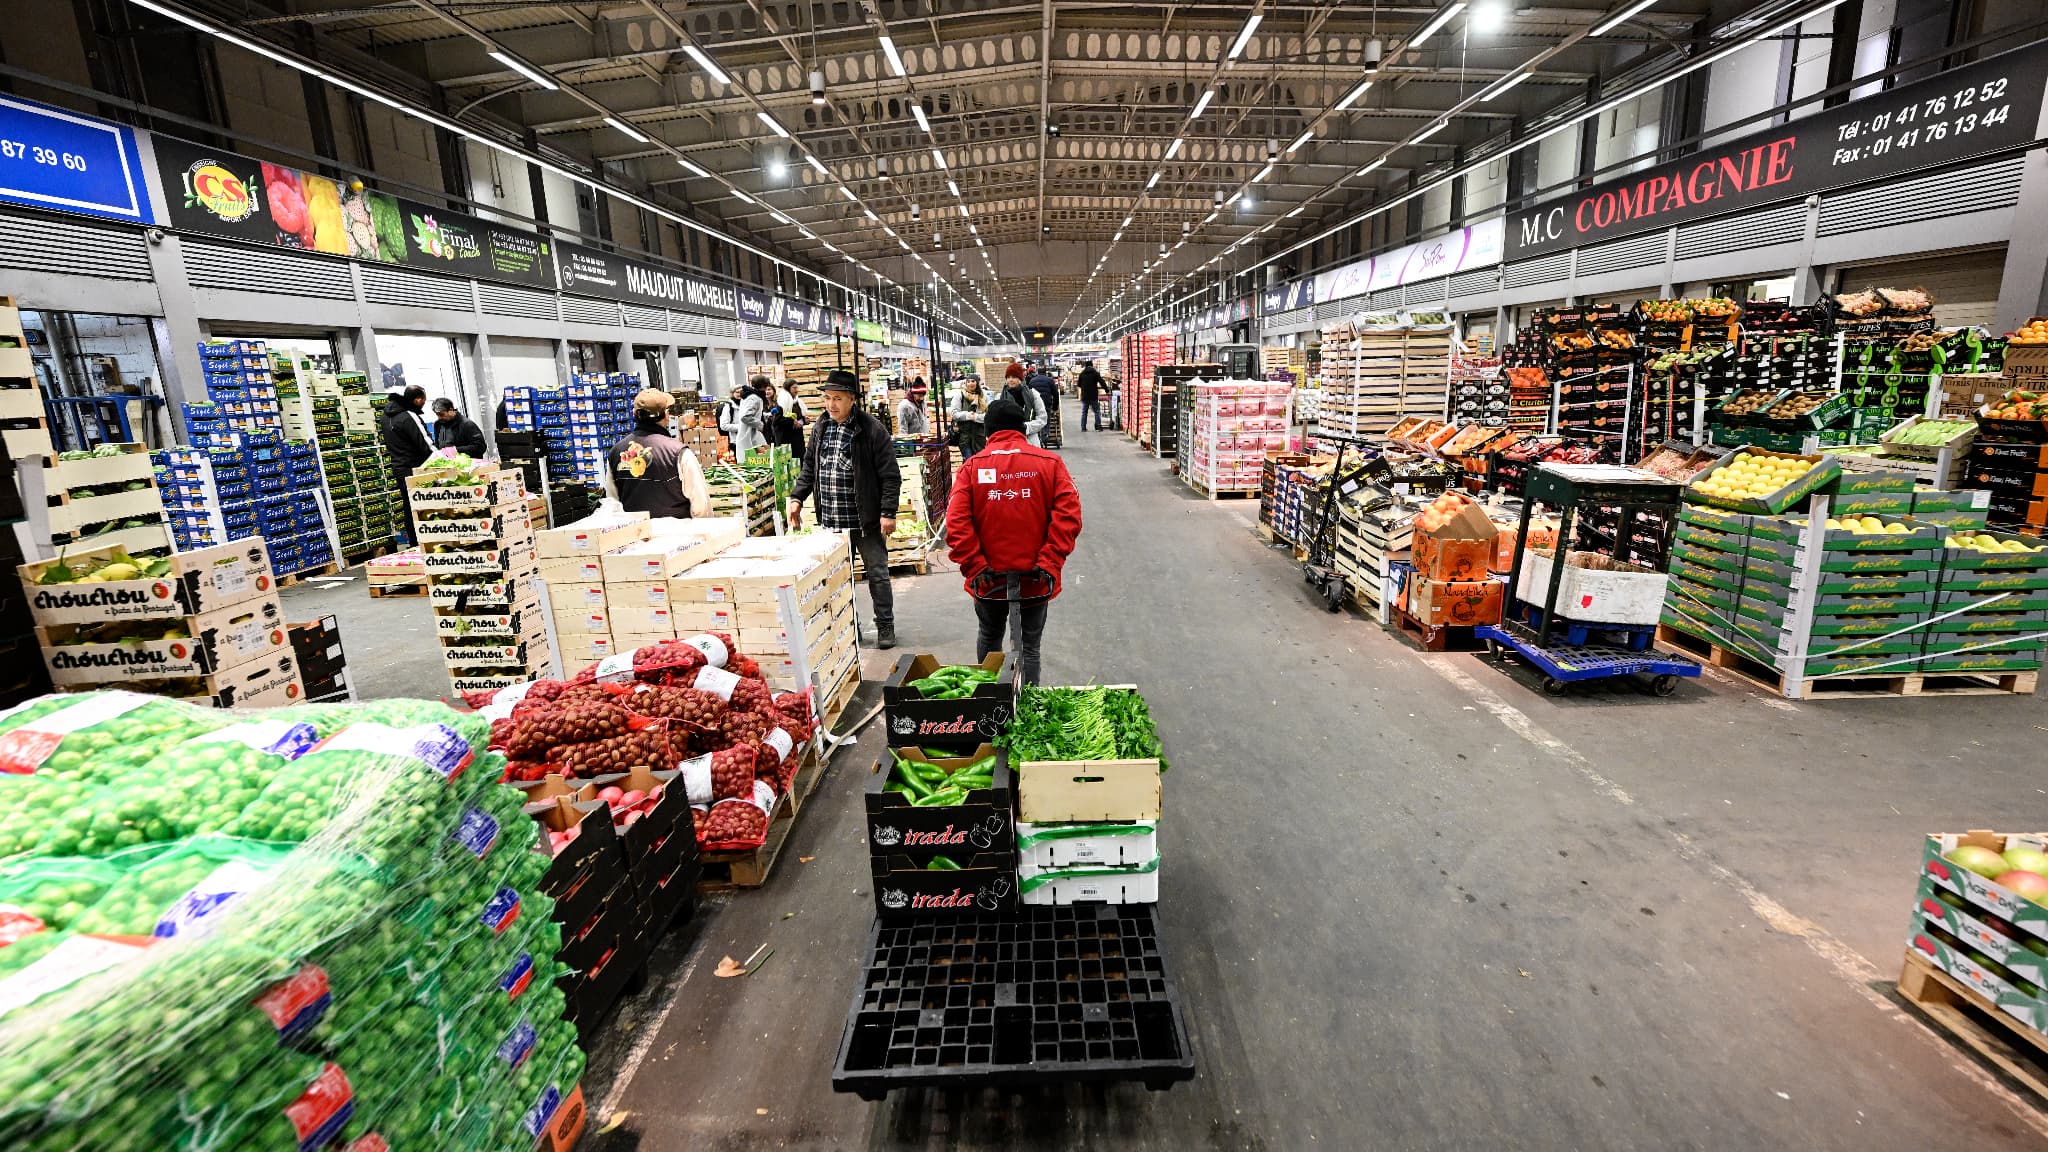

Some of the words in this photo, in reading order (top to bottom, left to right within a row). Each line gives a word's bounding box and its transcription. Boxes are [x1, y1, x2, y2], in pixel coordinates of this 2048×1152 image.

[1838, 121, 1860, 142] Tél
[1872, 112, 1891, 132] 01
[1896, 104, 1918, 125] 41
[1923, 96, 1947, 118] 76
[1953, 88, 1975, 109] 12
[1979, 77, 2008, 101] 52
[1833, 148, 1860, 166] Fax
[1872, 136, 1891, 156] 01
[1897, 128, 1919, 149] 41
[1925, 121, 1948, 143] 76
[1954, 113, 1977, 135] 13
[1981, 105, 2010, 127] 44
[1, 140, 26, 160] 87
[33, 147, 58, 166] 39
[63, 153, 87, 172] 60
[195, 175, 246, 202] CS
[1520, 205, 1564, 248] M.C
[1575, 137, 1796, 232] COMPAGNIE
[440, 228, 475, 249] Final
[626, 264, 684, 302] MAUDUIT
[686, 279, 735, 311] MICHELLE
[205, 346, 226, 354] Sigil
[208, 361, 229, 370] Sigil
[212, 376, 232, 385] Sigil
[215, 391, 236, 400] Sigil
[537, 390, 556, 399] Sigil
[190, 407, 211, 416] Sigil
[539, 403, 557, 413] Sigil
[541, 416, 559, 425] Sigil
[193, 422, 214, 431] Sigil
[249, 434, 268, 443] Sigil
[211, 453, 232, 462] Sigil
[216, 469, 236, 479] Sigil
[257, 465, 275, 474] Sigil
[260, 479, 278, 489] Sigil
[220, 485, 240, 495] Sigil
[987, 488, 1031, 500] 新今日
[266, 508, 284, 518] Sigil
[227, 515, 247, 525] Sigil
[269, 522, 287, 532] Sigil
[230, 529, 249, 540] Sigil
[275, 549, 293, 559] Sigil
[279, 562, 296, 573] Sigil
[142, 603, 176, 614] Portugal
[161, 662, 193, 673] Portugal
[270, 672, 297, 689] Portugal
[919, 715, 976, 735] irada
[904, 824, 968, 846] irada
[912, 888, 975, 908] irada
